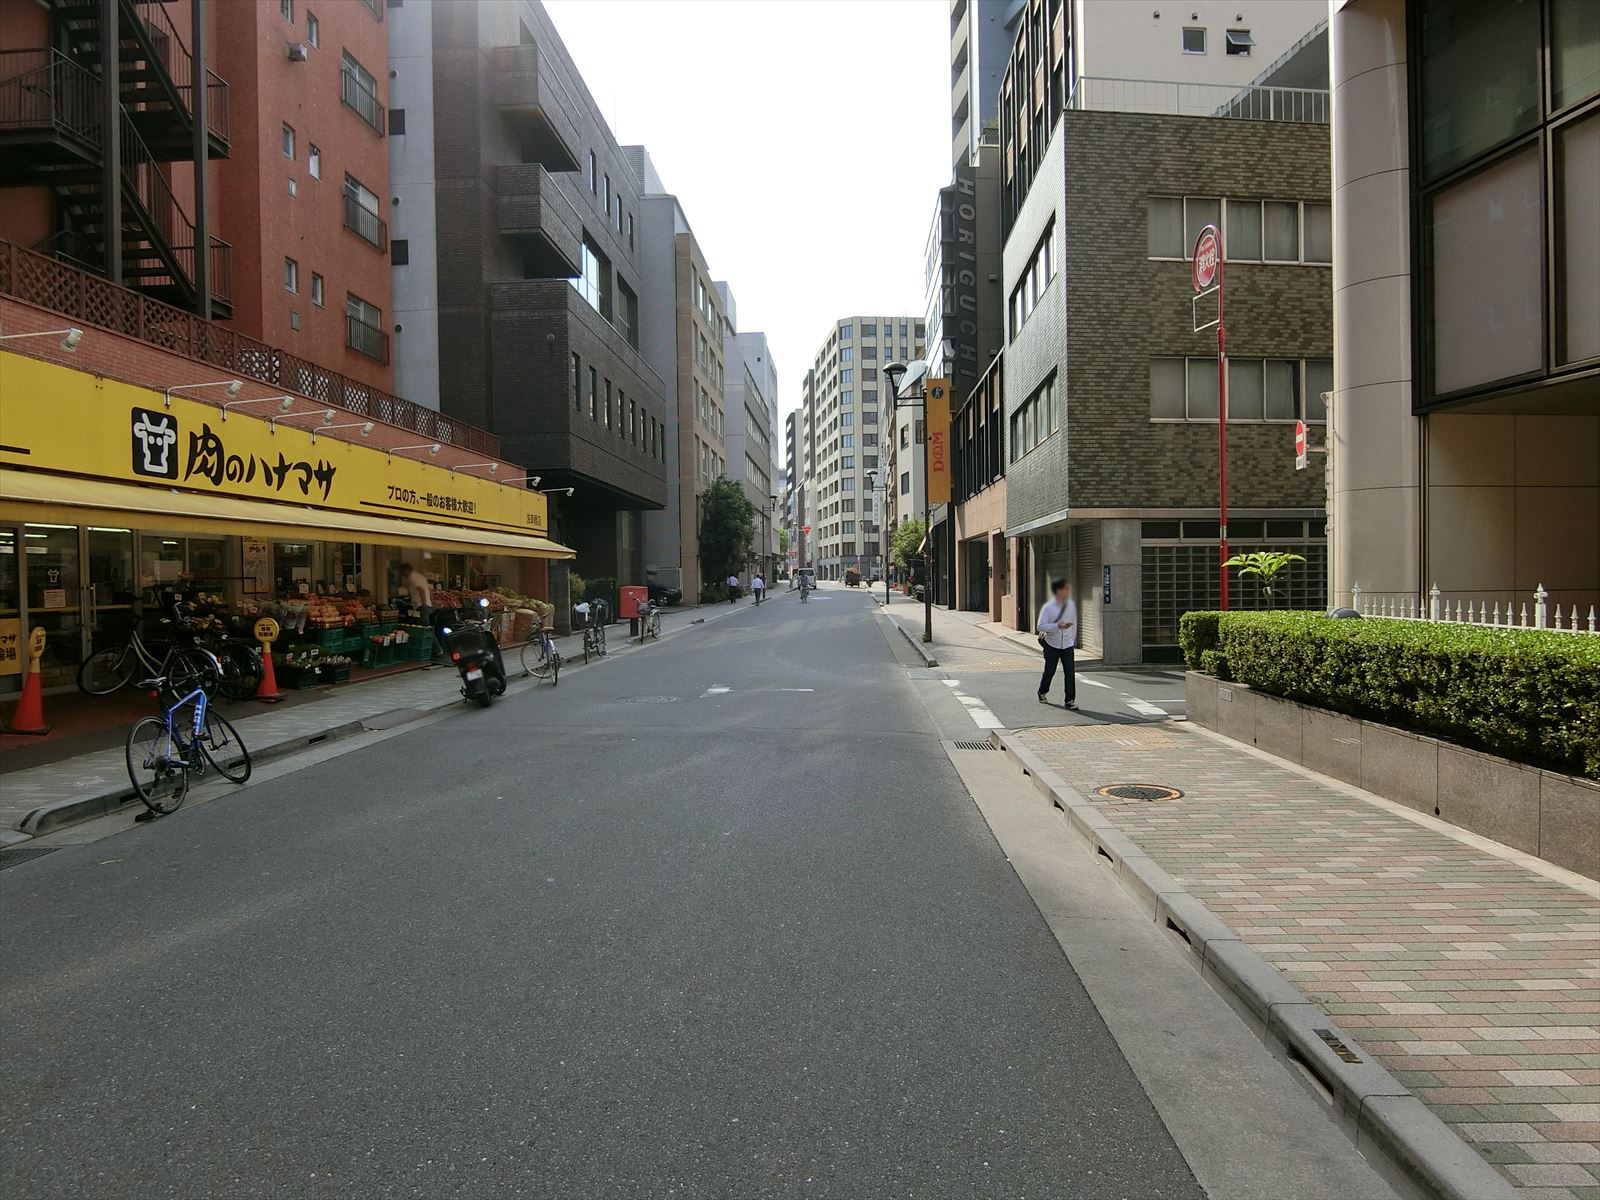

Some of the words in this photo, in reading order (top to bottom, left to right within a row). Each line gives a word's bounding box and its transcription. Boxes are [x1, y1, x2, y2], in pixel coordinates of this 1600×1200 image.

[957, 177, 976, 377] HORIGUCHI
[183, 422, 337, 502] 肉のハナマサ
